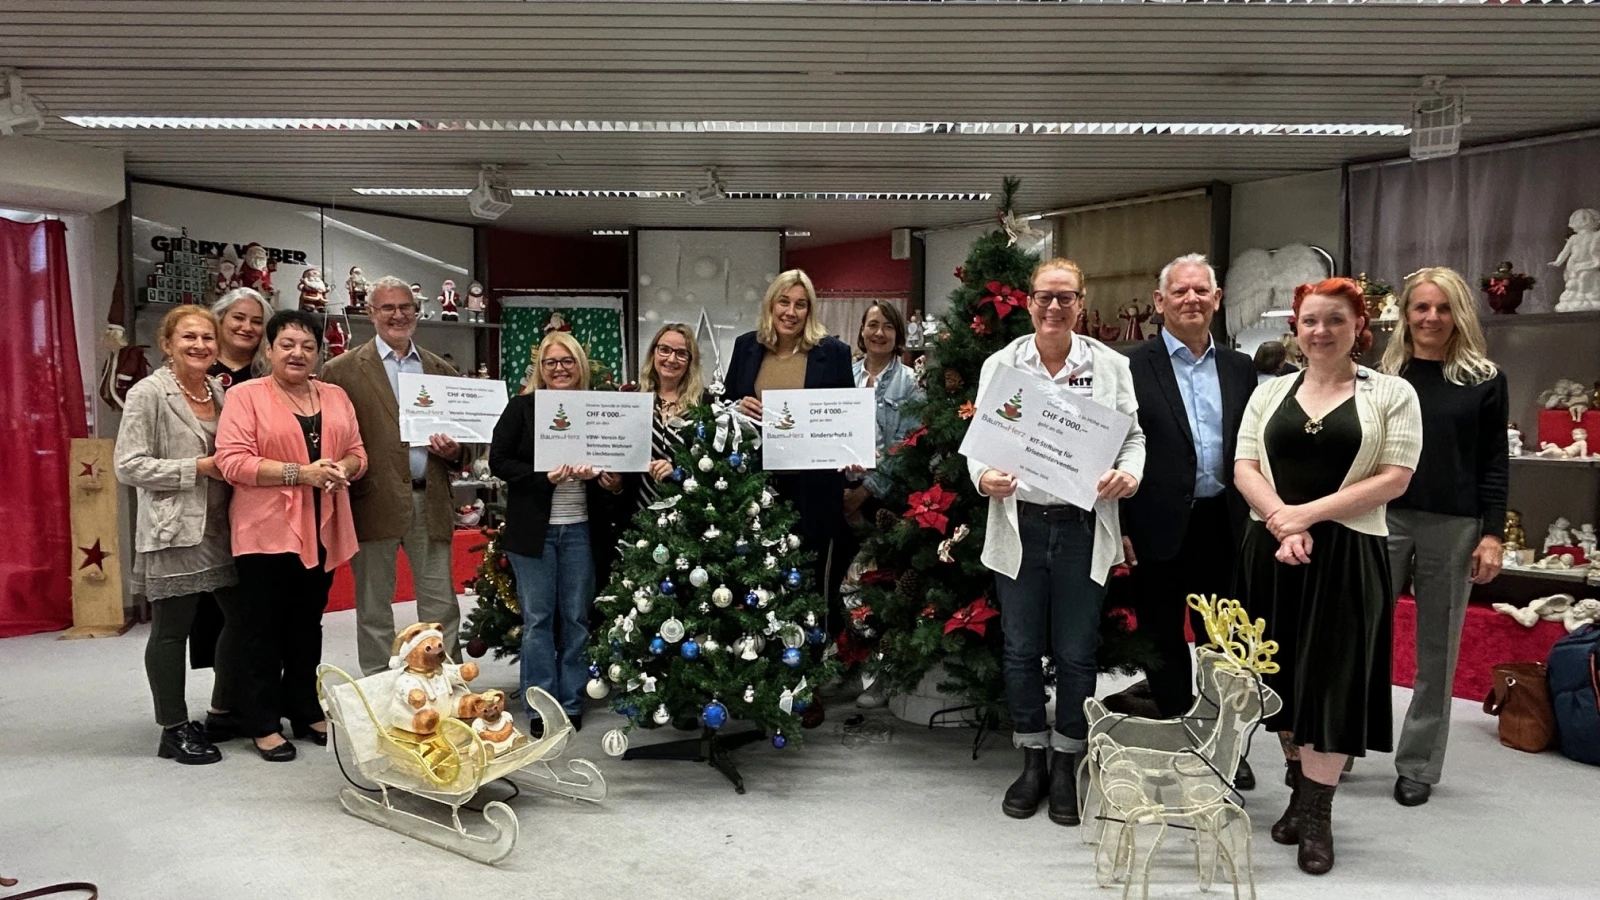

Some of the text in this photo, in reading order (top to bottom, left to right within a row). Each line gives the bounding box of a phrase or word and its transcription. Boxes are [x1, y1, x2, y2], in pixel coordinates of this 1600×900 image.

[151, 236, 308, 266] GRRY WBER
[1069, 376, 1093, 387] KIT
[1042, 410, 1058, 421] CHF
[1030, 436, 1073, 459] KIT-Stiftung für
[1025, 446, 1079, 474] Krisenintervention
